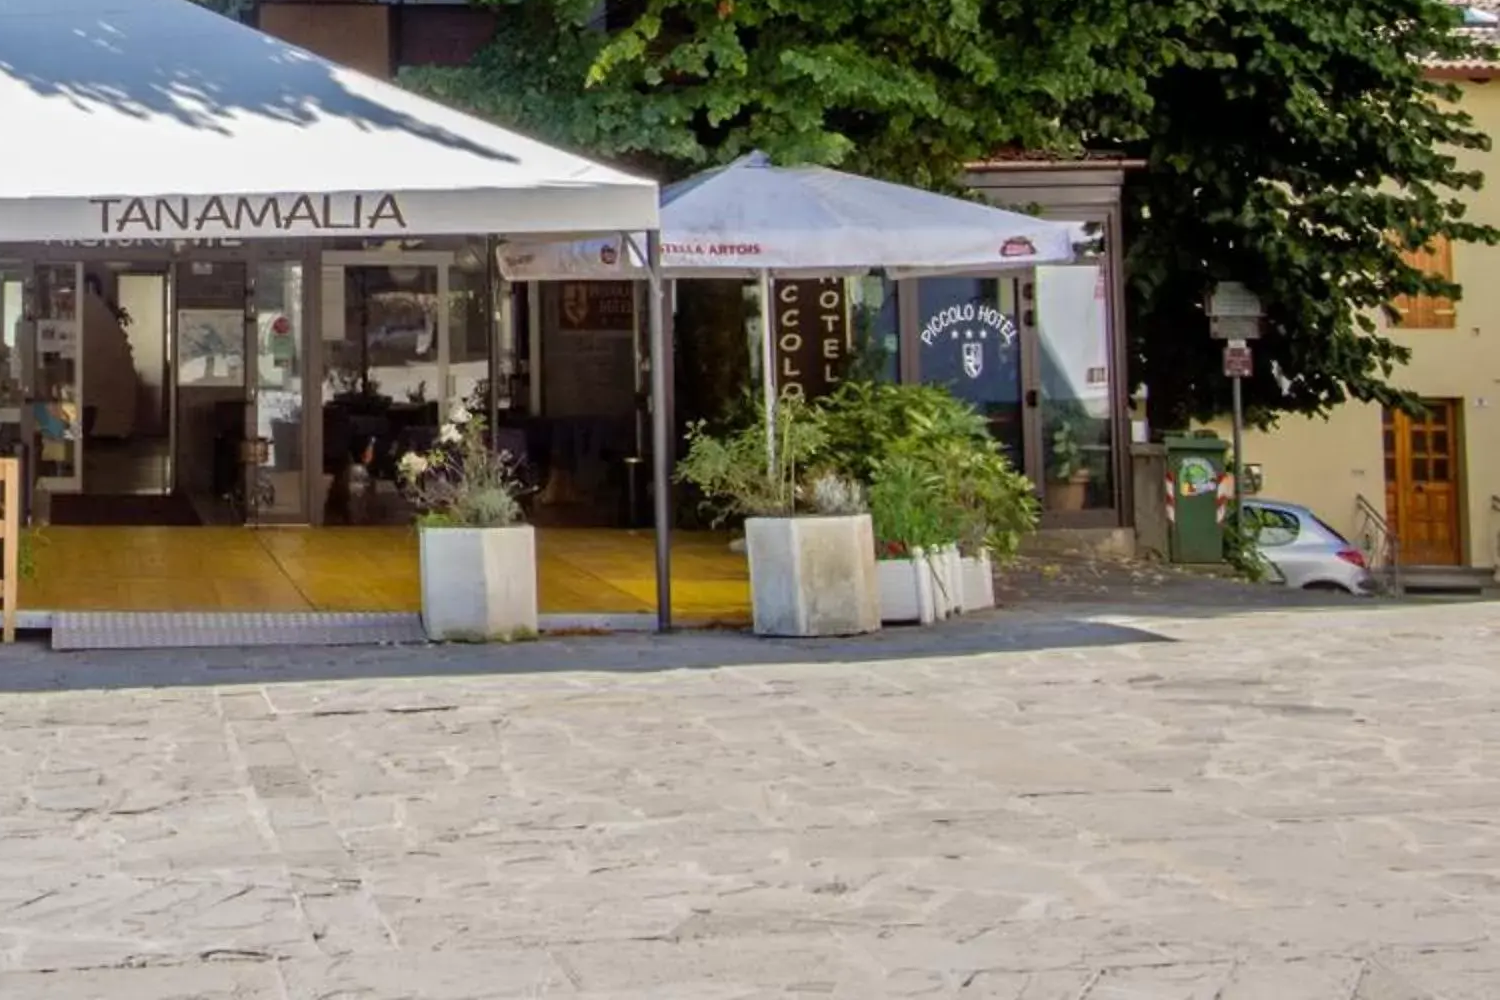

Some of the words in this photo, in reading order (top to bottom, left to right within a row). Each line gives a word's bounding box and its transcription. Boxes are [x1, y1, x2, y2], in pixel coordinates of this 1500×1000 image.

[90, 193, 407, 234] TANAMALIA
[661, 243, 703, 254] TELLA
[708, 242, 760, 255] ARTOIS
[920, 303, 975, 346] PICCOLO
[977, 304, 1018, 346] HOTEL
